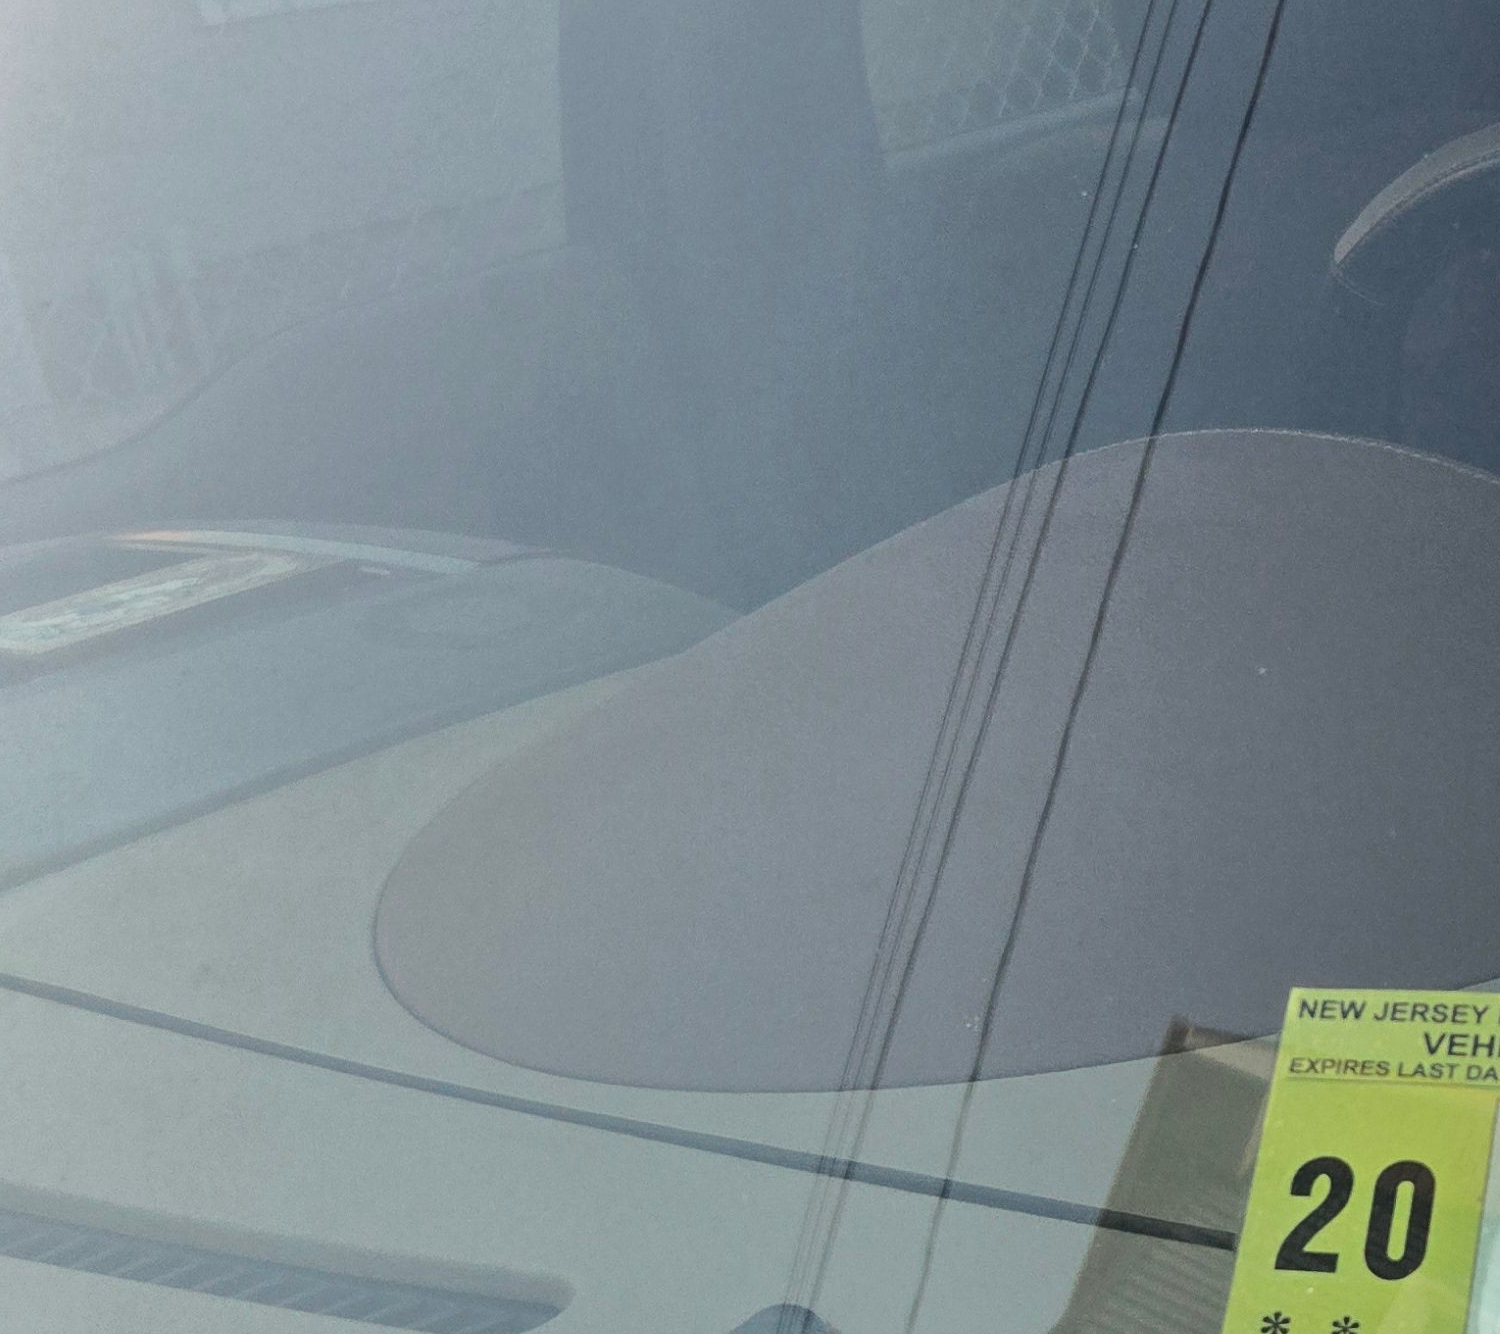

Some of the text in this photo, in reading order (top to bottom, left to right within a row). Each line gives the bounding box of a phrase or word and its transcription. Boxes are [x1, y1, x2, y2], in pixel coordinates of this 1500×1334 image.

[1299, 998, 1366, 1021] NEW
[1373, 1000, 1490, 1025] JERSEY
[1289, 1057, 1391, 1077] EXPIRES
[1396, 1062, 1461, 1080] LAST
[1274, 1155, 1436, 1281] 20
